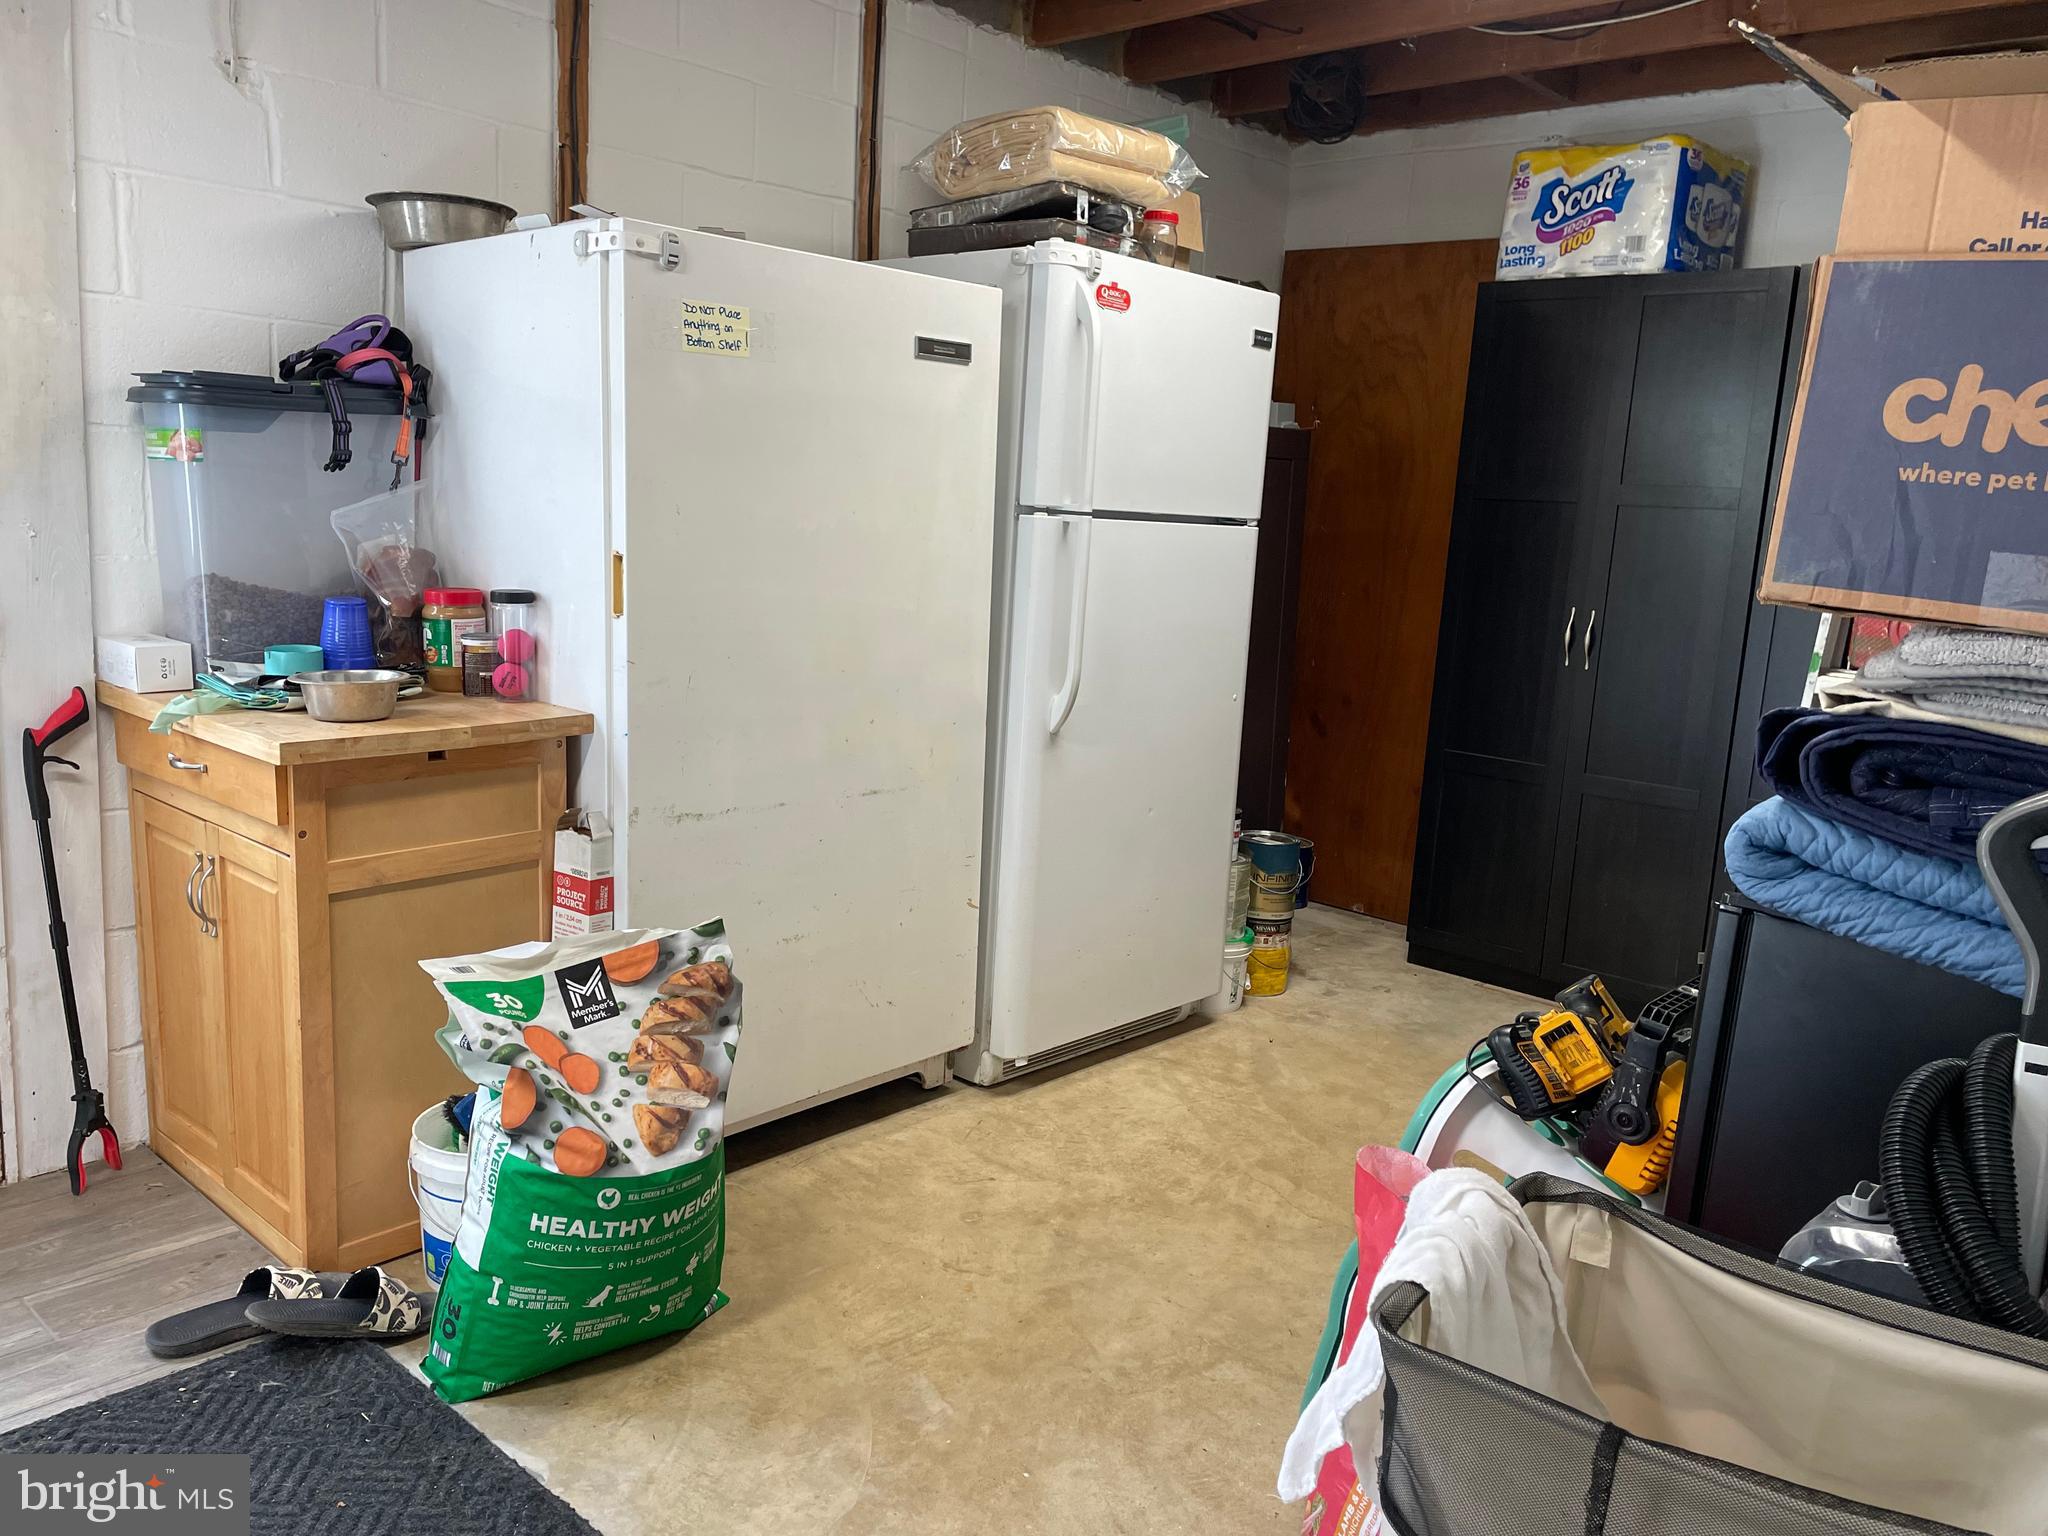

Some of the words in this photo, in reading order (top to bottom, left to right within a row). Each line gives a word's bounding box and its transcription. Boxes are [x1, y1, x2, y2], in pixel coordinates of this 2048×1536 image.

[1512, 175, 1531, 191] 36
[1544, 165, 1621, 226] Scott
[1504, 243, 1537, 256] Long
[1559, 225, 1596, 257] 1100
[1968, 237, 2014, 253] Call
[1499, 253, 1546, 270] Lasting
[698, 304, 716, 316] NOT
[718, 306, 742, 320] Place
[683, 318, 721, 336] Anything
[723, 324, 734, 333] on
[684, 333, 715, 349] Bottom
[1898, 461, 1983, 487] where
[1986, 471, 2039, 495] pet
[556, 886, 587, 903] PROJECT
[485, 992, 524, 1010] 30
[571, 999, 615, 1020] Member's
[583, 1011, 608, 1024] Mark
[487, 1141, 509, 1207] WEIGHT
[628, 1193, 640, 1201] REAL
[641, 1190, 660, 1200] CHICKEN
[666, 1186, 676, 1194] THE
[529, 1212, 656, 1239] HEALTHY
[662, 1171, 722, 1229] WEIGHT
[526, 1239, 573, 1253] CHICKEN
[584, 1240, 642, 1254] VEGETABLE
[643, 1231, 675, 1248] RECIPE
[675, 1224, 691, 1237] FOR
[608, 1261, 615, 1271] 5
[616, 1259, 630, 1269] IN
[635, 1246, 677, 1266] SUPPORT
[278, 1277, 298, 1290] NIKE
[614, 1291, 639, 1304] HEALTHY
[660, 1276, 680, 1290] SYSTEM
[507, 1297, 518, 1307] HIP
[518, 1300, 525, 1309] &
[525, 1301, 544, 1310] JOINT
[546, 1302, 570, 1310] HEALTH
[442, 1296, 462, 1340] 30
[574, 1325, 593, 1335] HELPS
[593, 1318, 619, 1331] CONVERT
[619, 1315, 631, 1325] FAT
[572, 1334, 581, 1343] TO
[581, 1329, 604, 1341] ENERGY
